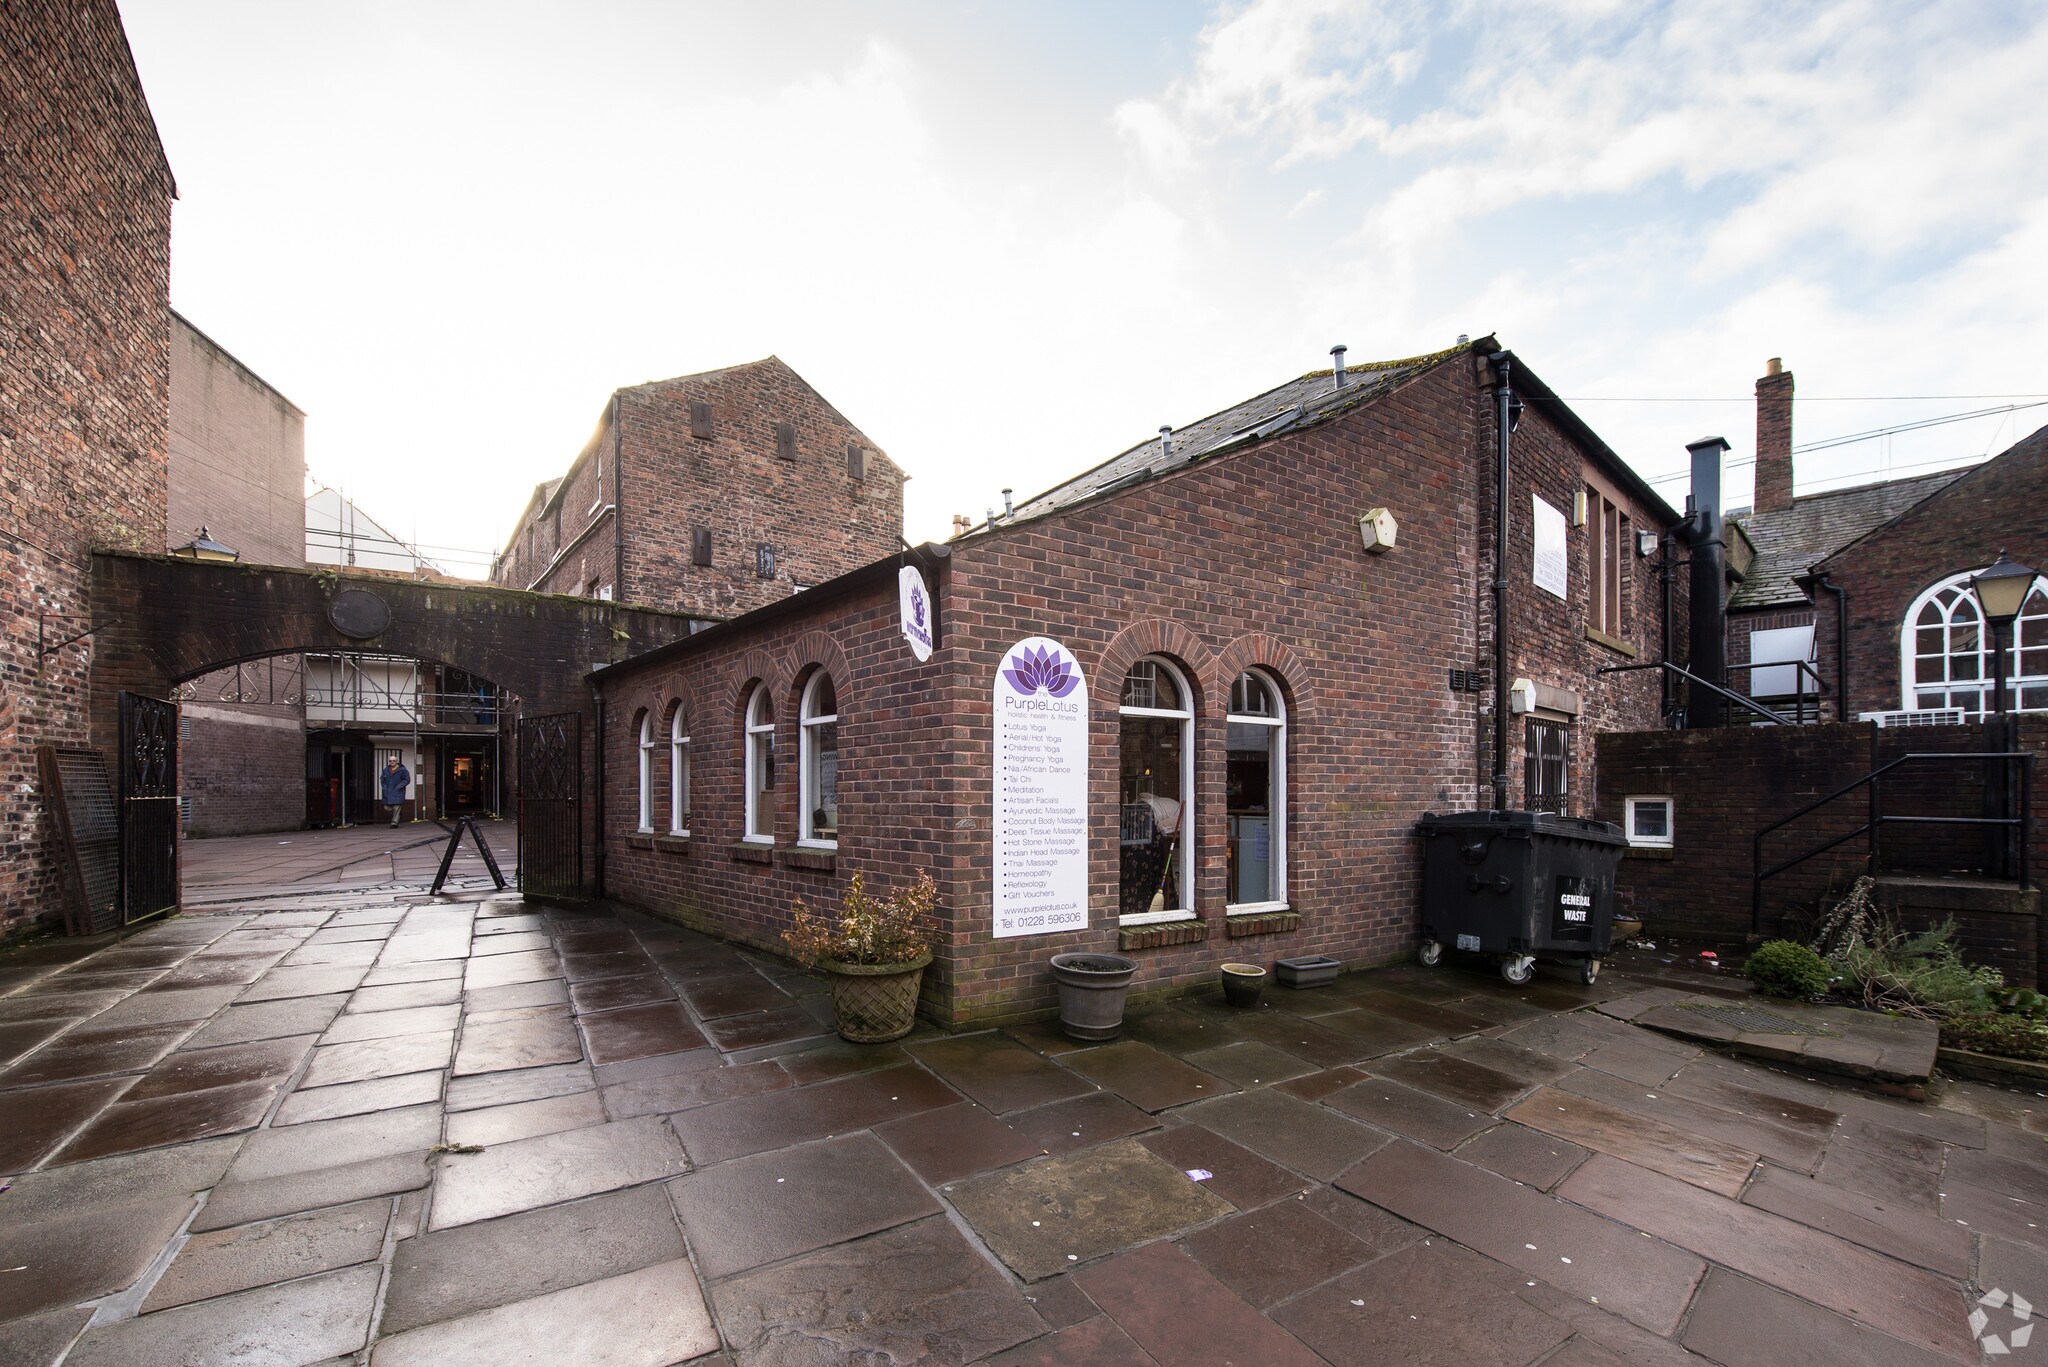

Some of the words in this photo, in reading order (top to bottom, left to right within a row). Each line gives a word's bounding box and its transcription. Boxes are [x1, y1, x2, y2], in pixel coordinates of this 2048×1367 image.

[1006, 696, 1078, 713] PurpleLotus
[1030, 724, 1046, 732] Yoga
[1009, 734, 1043, 742] Aerial/Hot
[1008, 755, 1045, 763] Pregnancy
[1047, 756, 1063, 764] Yoga
[1045, 807, 1075, 815] Massage
[1008, 870, 1052, 878] Homeopathy
[1561, 894, 1590, 907] GENERAL
[1004, 902, 1077, 914] www.purplelotus.co.uk
[1001, 919, 1014, 928] Tel:
[1018, 916, 1044, 927] 01228
[1048, 913, 1081, 924] 596306
[1564, 909, 1586, 922] WASTE
